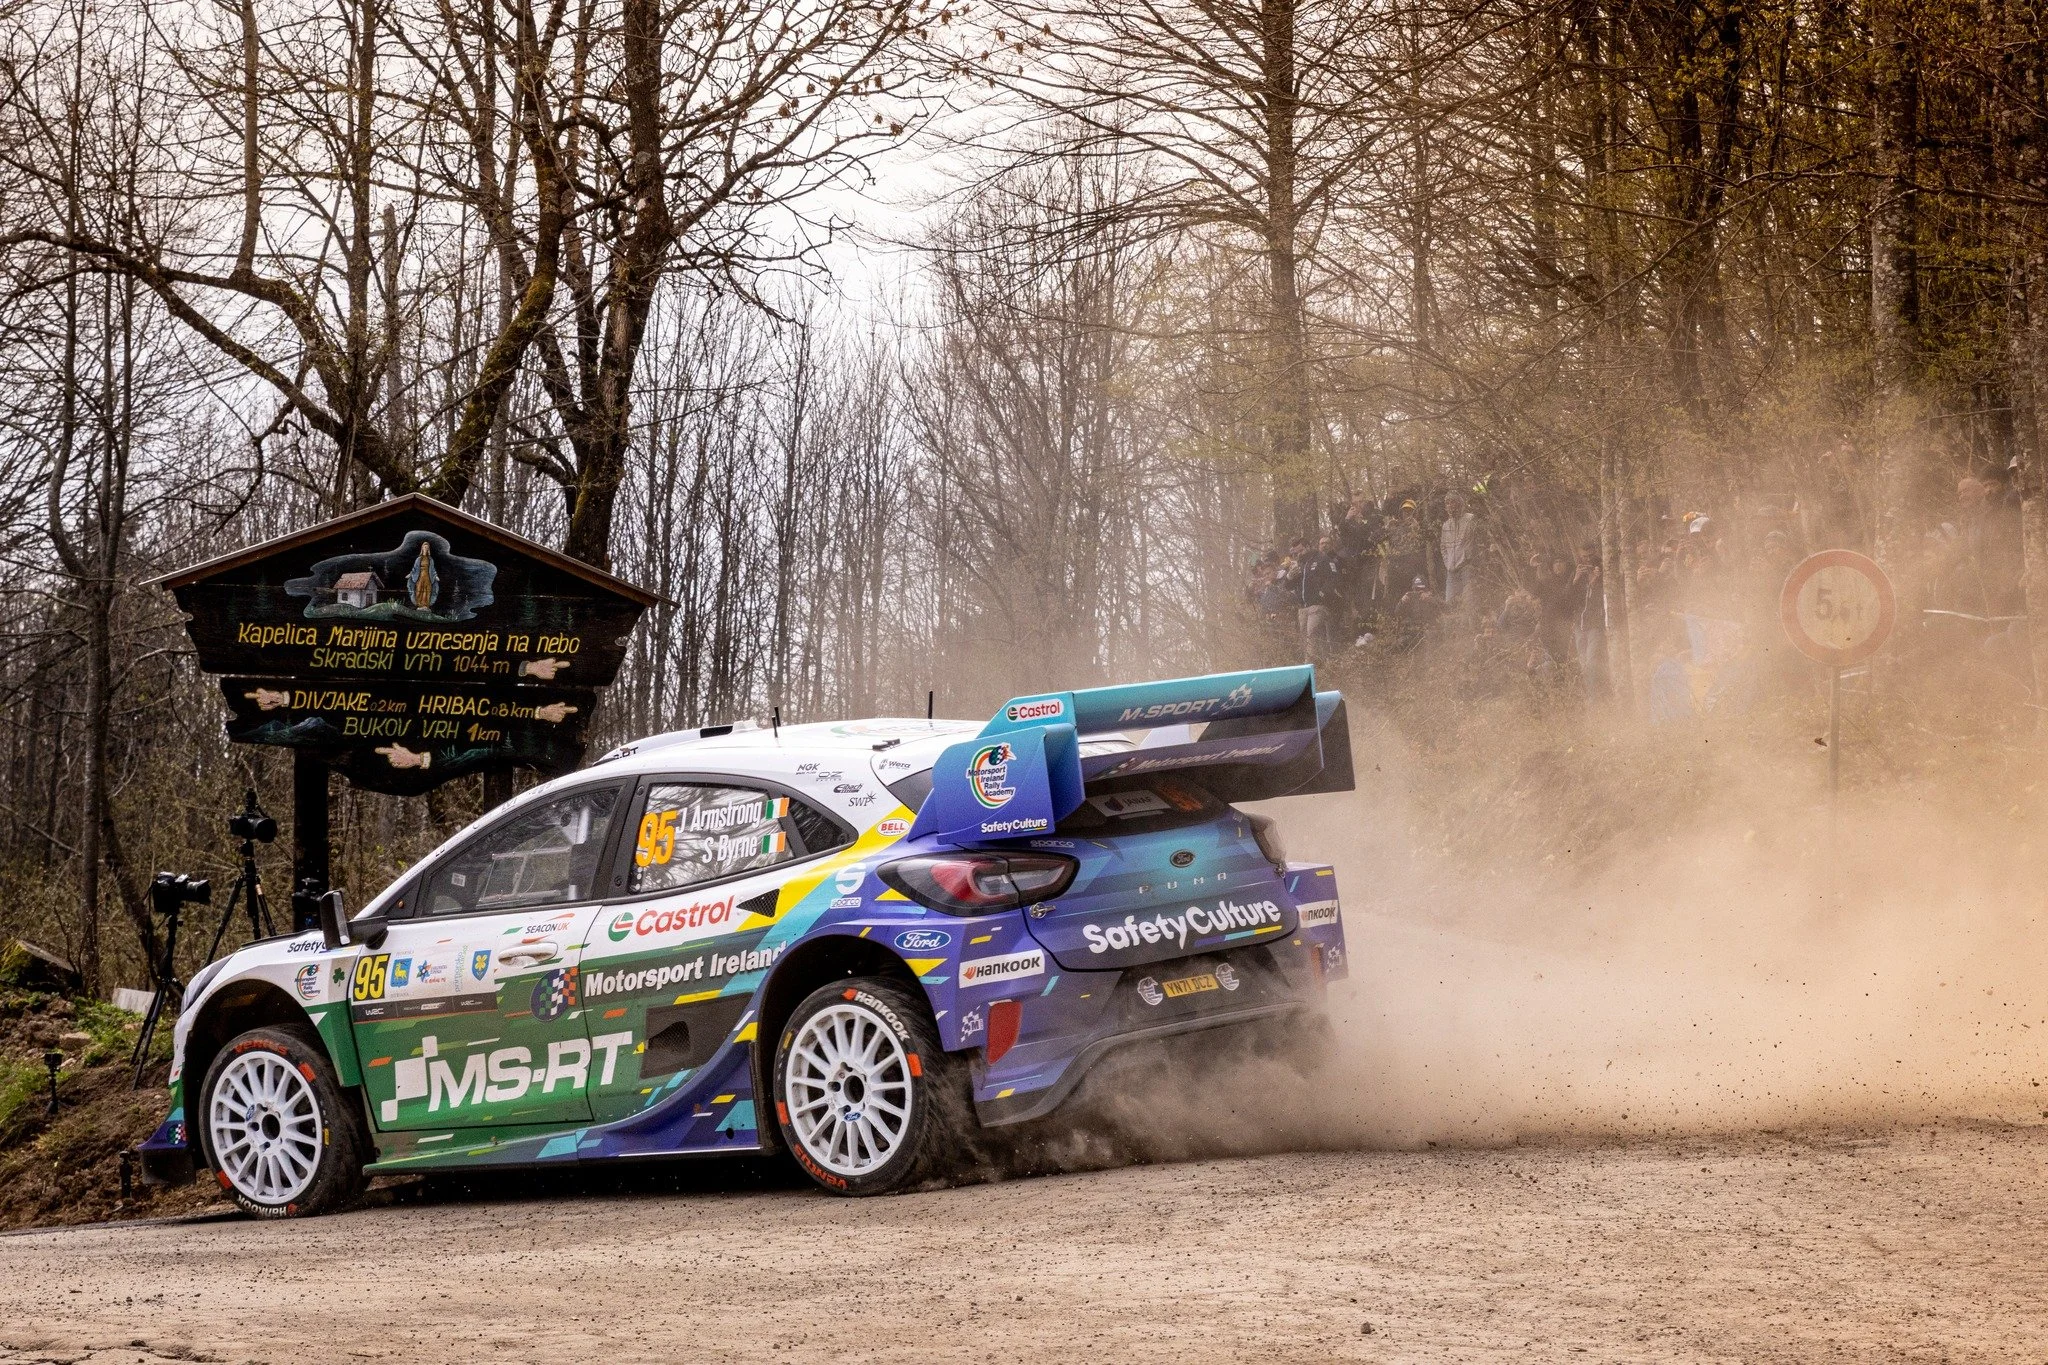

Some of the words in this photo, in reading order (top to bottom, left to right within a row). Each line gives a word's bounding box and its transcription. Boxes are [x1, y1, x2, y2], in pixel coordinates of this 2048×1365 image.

[238, 622, 317, 648] Kapelica
[326, 625, 398, 650] Marijina
[405, 630, 499, 655] uznesenja
[506, 634, 530, 653] na
[536, 632, 581, 654] nebo
[309, 647, 394, 670] Skradski
[453, 654, 489, 673] 1044
[492, 660, 510, 674] m
[291, 690, 371, 711] DIVJAKE
[418, 694, 491, 716] HRIBAC
[1019, 701, 1060, 719] Castrol
[1118, 698, 1220, 722] M-SPORT
[342, 716, 412, 737] BUKOV
[422, 719, 460, 739] VRH
[797, 763, 820, 772] NGK
[967, 765, 1006, 777] Motorsport
[981, 774, 1005, 783] Ireland
[984, 782, 1000, 791] Rally
[984, 787, 1015, 797] Academy
[676, 807, 688, 833] J
[690, 801, 763, 832] Armstrong
[881, 822, 906, 832] BELL
[635, 810, 678, 867] 95
[702, 836, 714, 864] S
[716, 834, 758, 865] Byrne
[635, 894, 735, 937] Castrol
[902, 932, 940, 948] Ford
[354, 954, 389, 1000] 95
[584, 962, 703, 997] Motorsport
[427, 1031, 633, 1113] MS-RT
